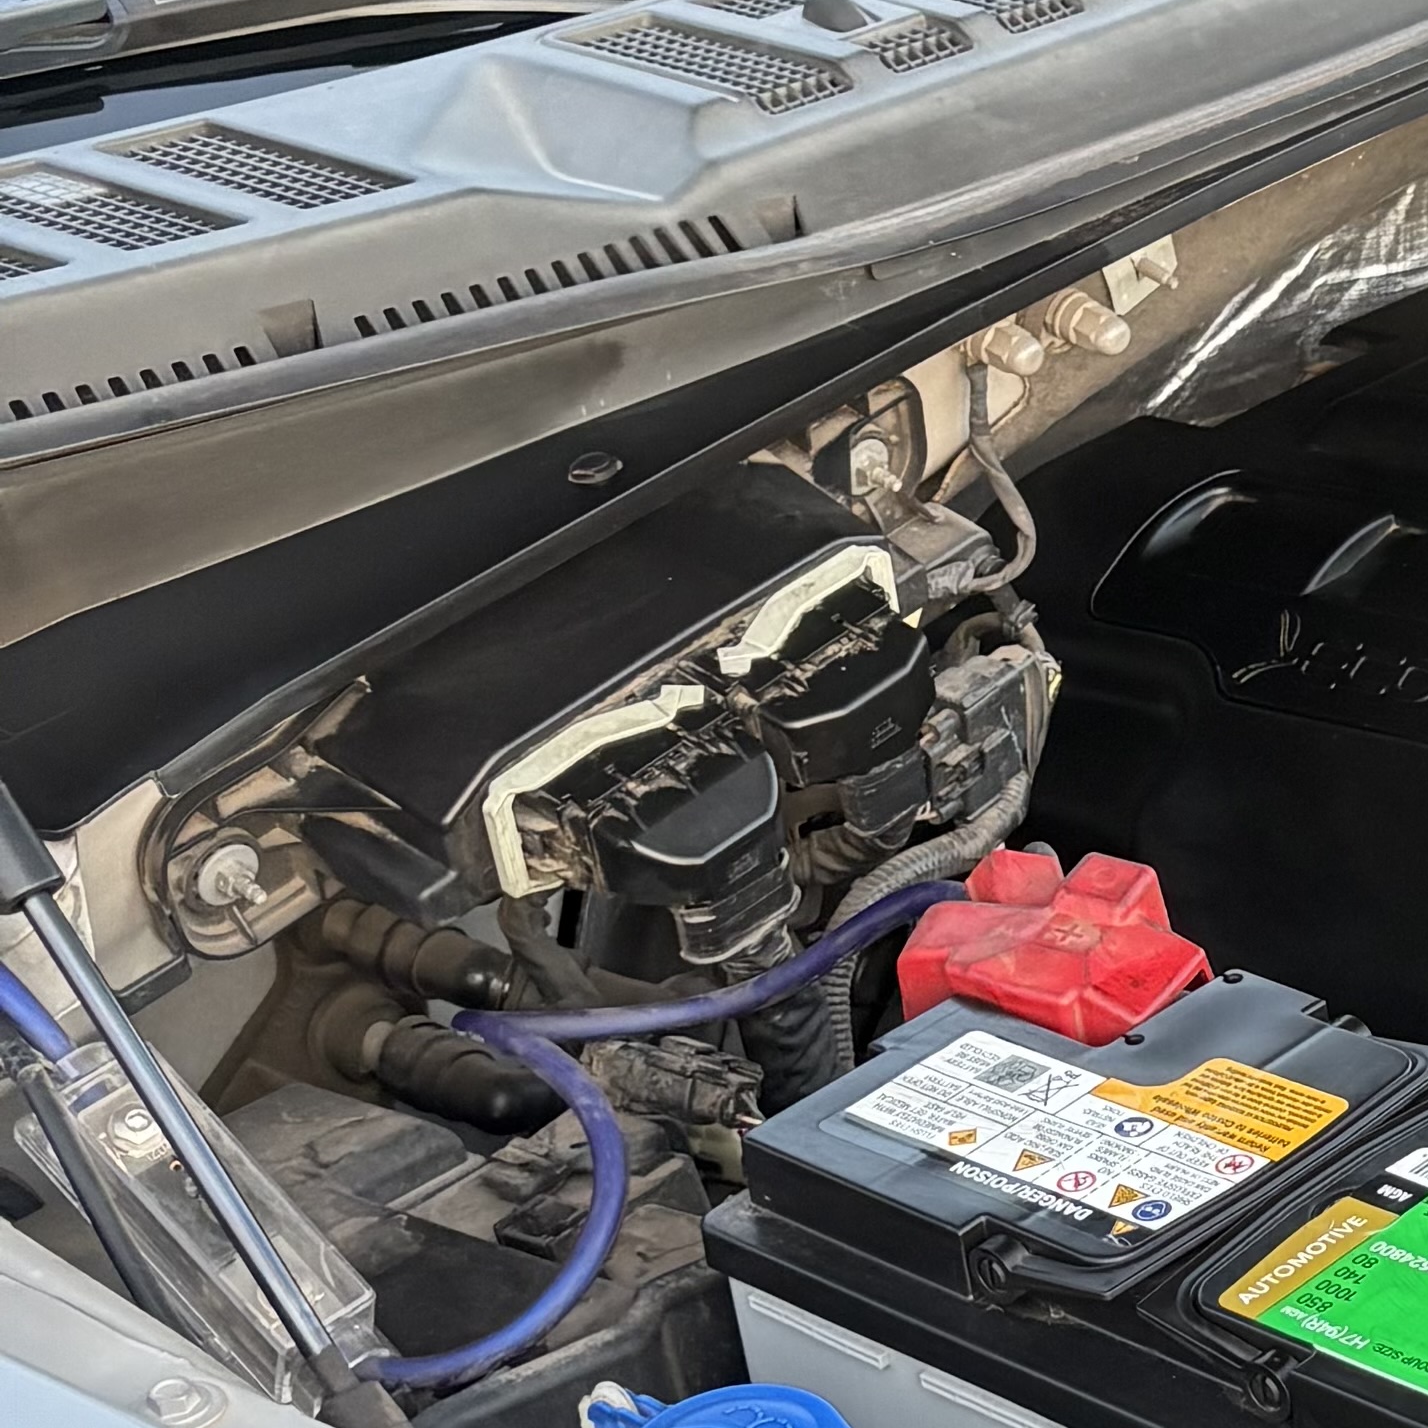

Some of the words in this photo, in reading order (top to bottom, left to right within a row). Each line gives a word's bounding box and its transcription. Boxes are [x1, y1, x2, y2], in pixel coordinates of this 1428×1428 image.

[1149, 1105, 1177, 1118] used
[1151, 1094, 1202, 1115] Wholesale
[1173, 1114, 1196, 1125] and
[1200, 1111, 1237, 1127] Costco
[1194, 1121, 1238, 1140] warranty
[1244, 1127, 1291, 1147] batteries
[1233, 1136, 1271, 1152] Return
[947, 1161, 1094, 1219] DANGER/POISON
[1375, 1183, 1414, 1202] AGM
[1237, 1214, 1368, 1306] AUTOMOTIVE
[1350, 1251, 1380, 1269] 80
[1332, 1265, 1368, 1284] 140
[1314, 1278, 1359, 1301] 1000
[1279, 1304, 1308, 1319] AGM
[1294, 1291, 1335, 1313] 850
